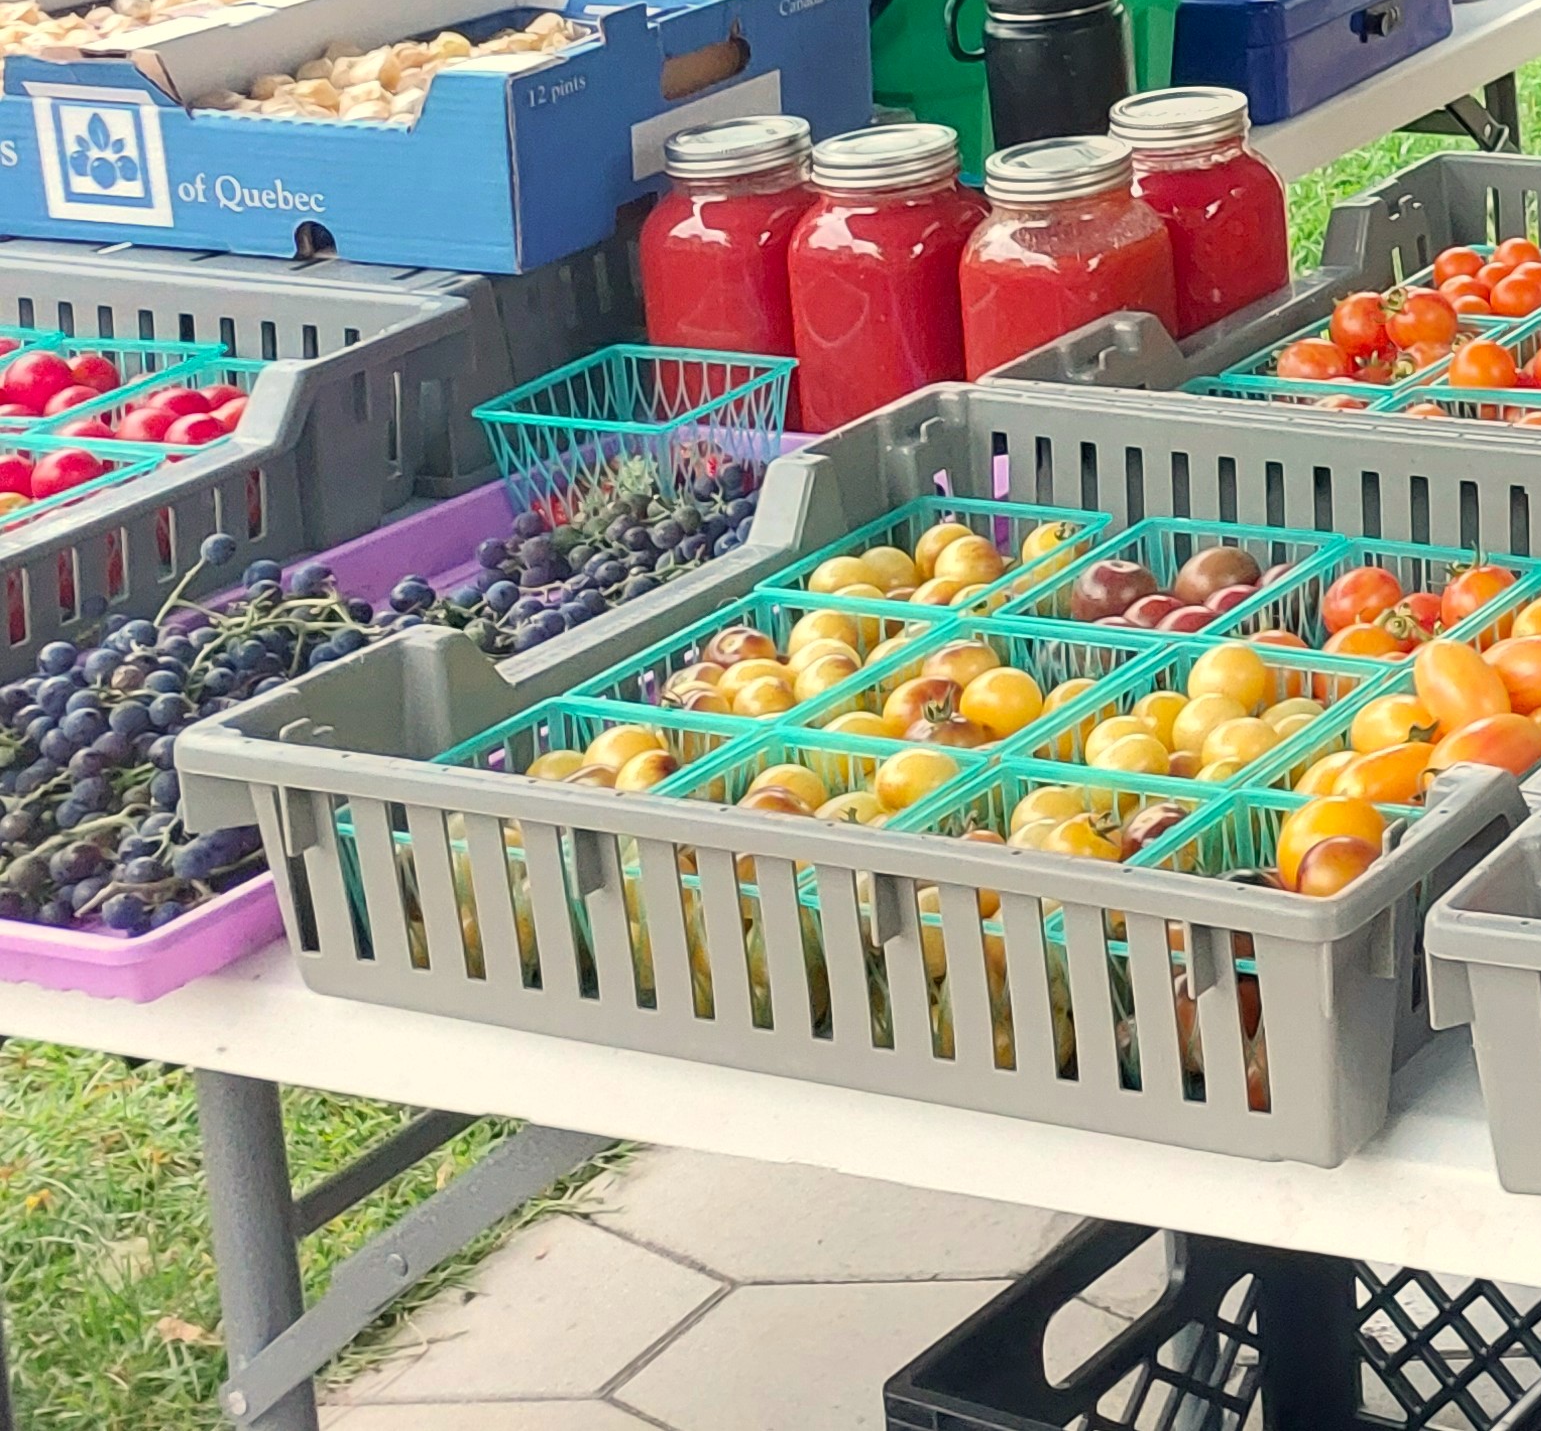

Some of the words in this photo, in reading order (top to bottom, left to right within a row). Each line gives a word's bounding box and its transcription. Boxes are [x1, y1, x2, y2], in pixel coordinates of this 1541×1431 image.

[529, 85, 547, 108] 12
[551, 75, 586, 104] pints
[178, 172, 207, 203] of
[214, 174, 327, 213] Quebec
